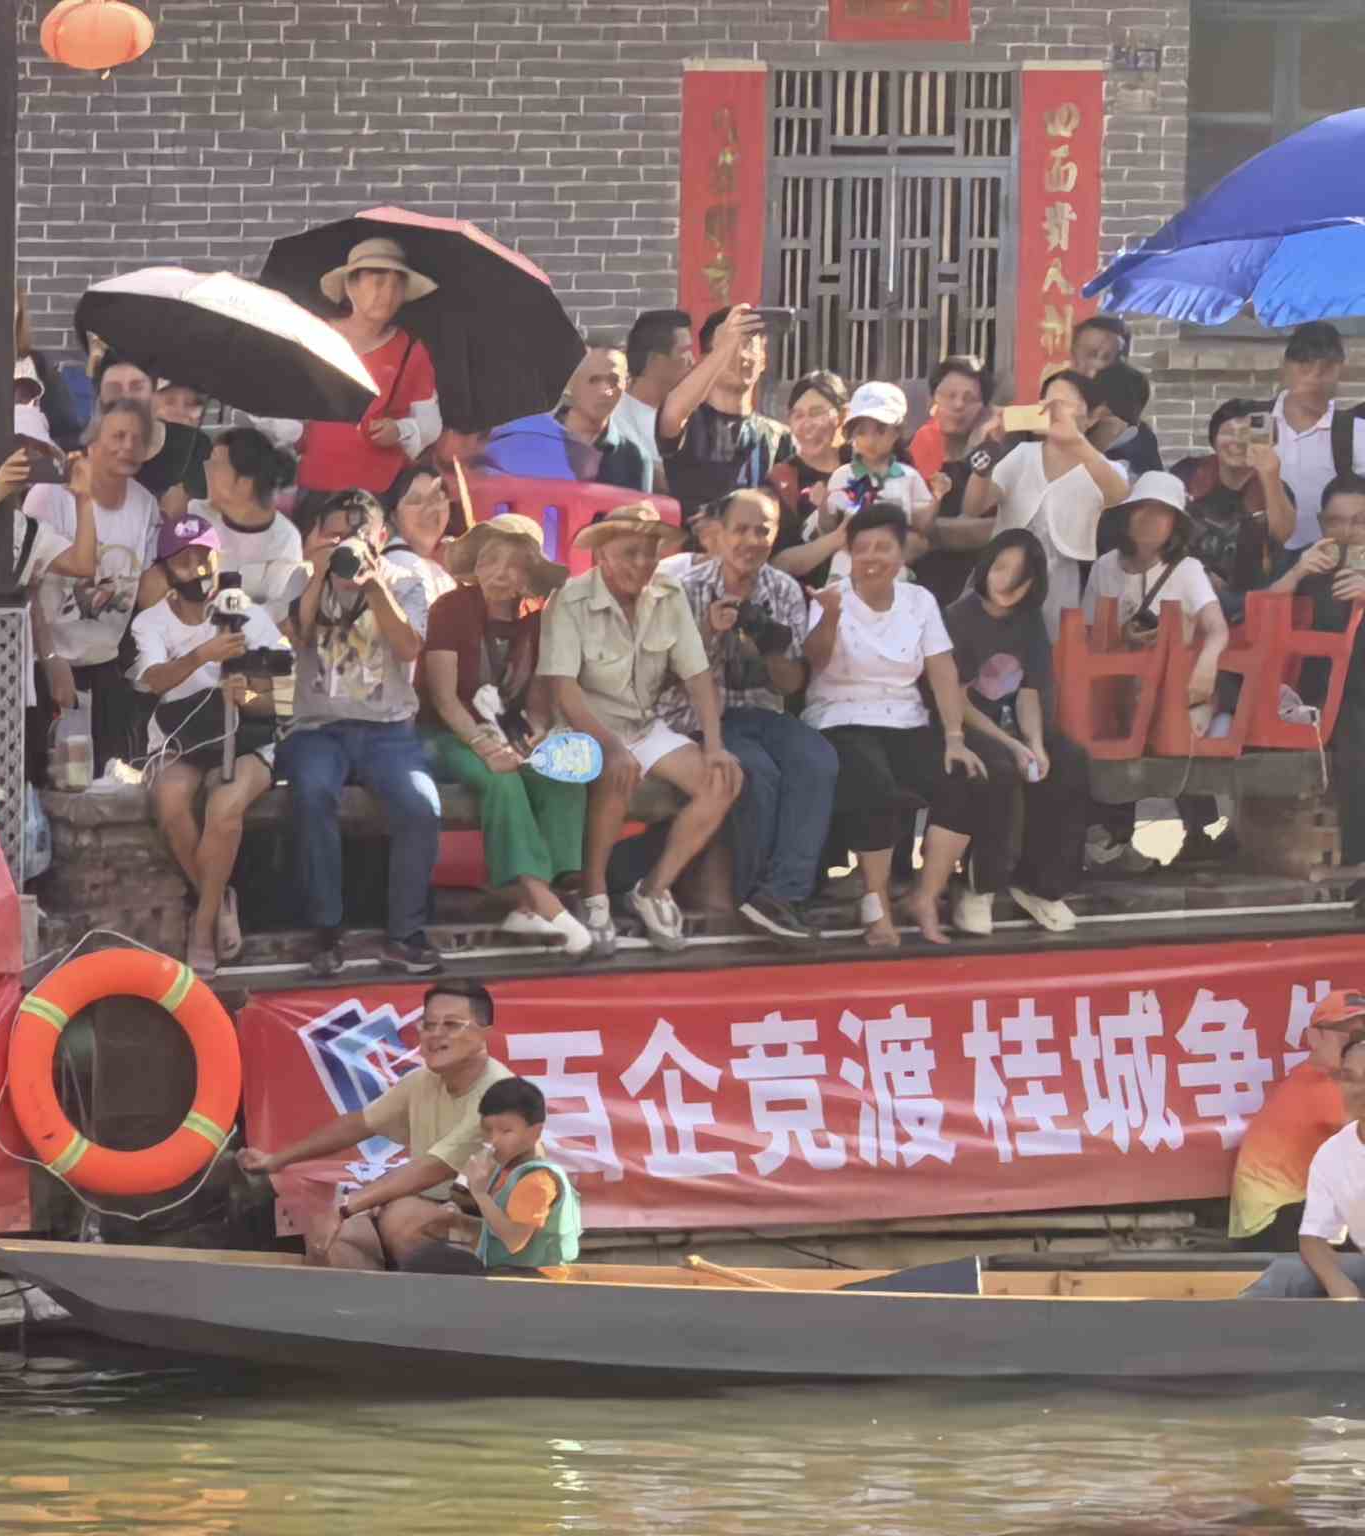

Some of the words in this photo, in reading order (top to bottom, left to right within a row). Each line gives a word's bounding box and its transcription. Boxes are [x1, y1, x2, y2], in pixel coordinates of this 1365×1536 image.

[505, 980, 1333, 1181] 百企竞渡桂城争
